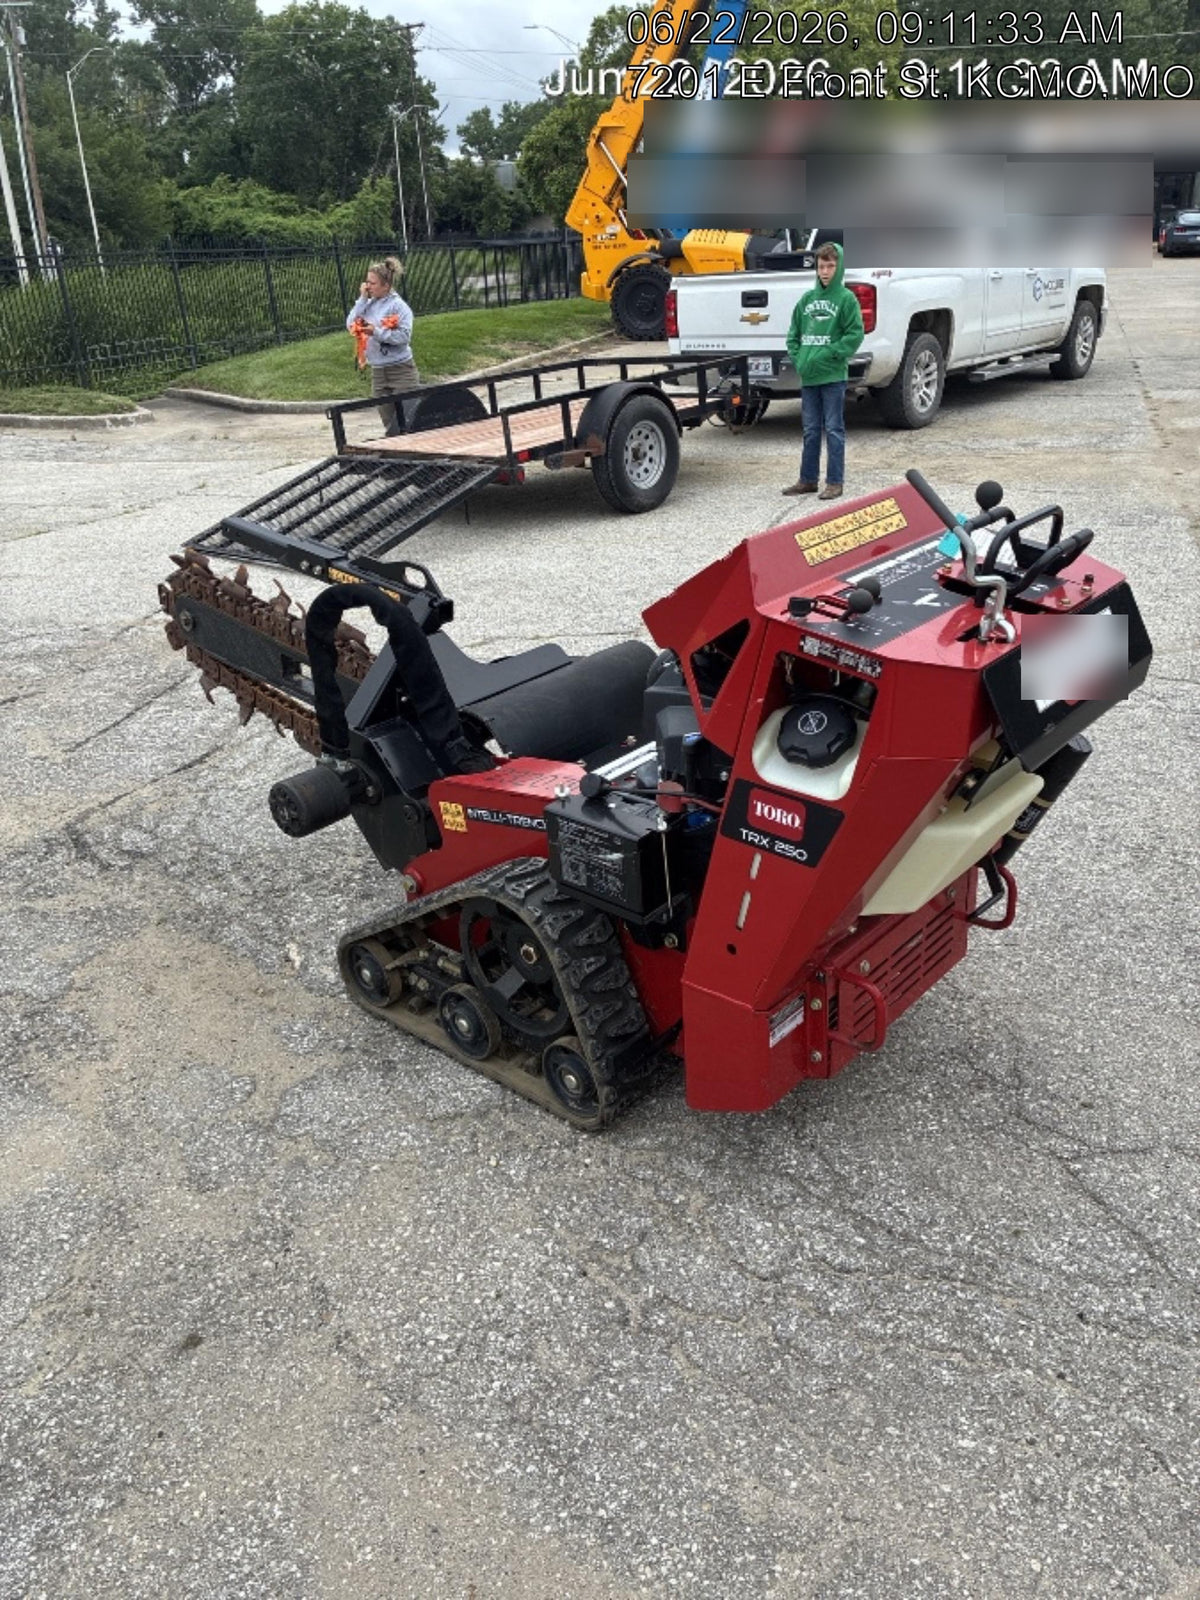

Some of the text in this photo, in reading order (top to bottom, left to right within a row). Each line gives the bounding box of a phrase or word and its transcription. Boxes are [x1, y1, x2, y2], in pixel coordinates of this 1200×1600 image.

[466, 807, 548, 831] INTELLI-TRENC
[753, 800, 802, 829] TORO
[739, 828, 808, 861] TRX 250
